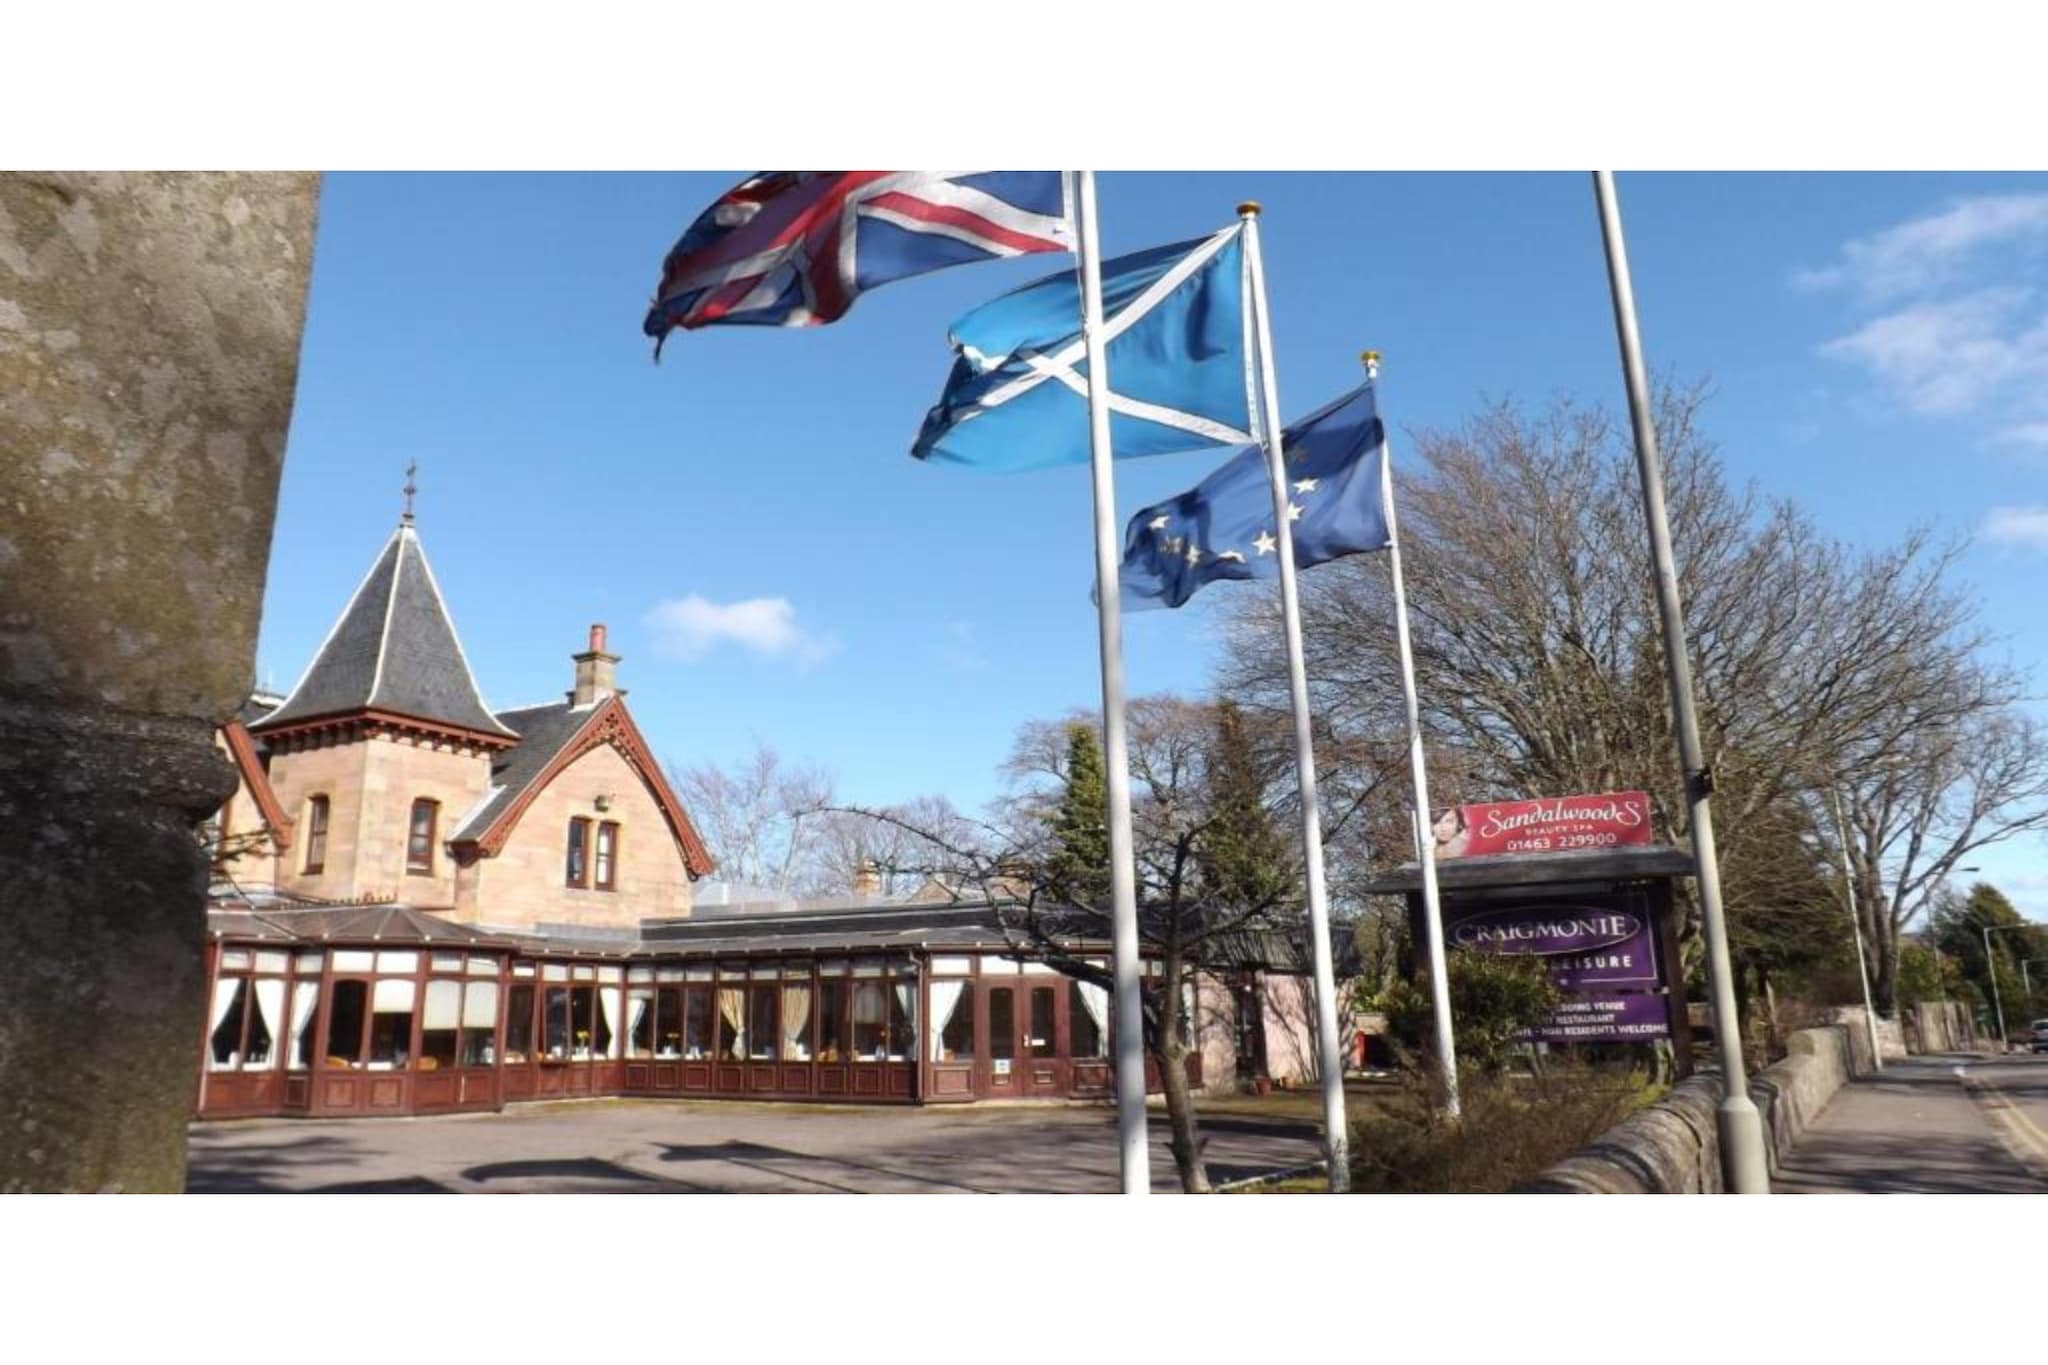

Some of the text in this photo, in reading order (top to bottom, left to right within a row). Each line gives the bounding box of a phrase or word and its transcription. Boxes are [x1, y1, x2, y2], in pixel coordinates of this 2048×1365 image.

[1525, 823, 1594, 836] BEAUTY SPA
[1507, 833, 1617, 851] 01463 229900
[1455, 915, 1627, 943] CRAIGMONTE
[1593, 1001, 1626, 1011] VENUE
[1556, 1013, 1615, 1024] RESTAURANT
[1564, 1025, 1617, 1036] RESIDENTS
[1617, 1023, 1668, 1034] WELCOME
